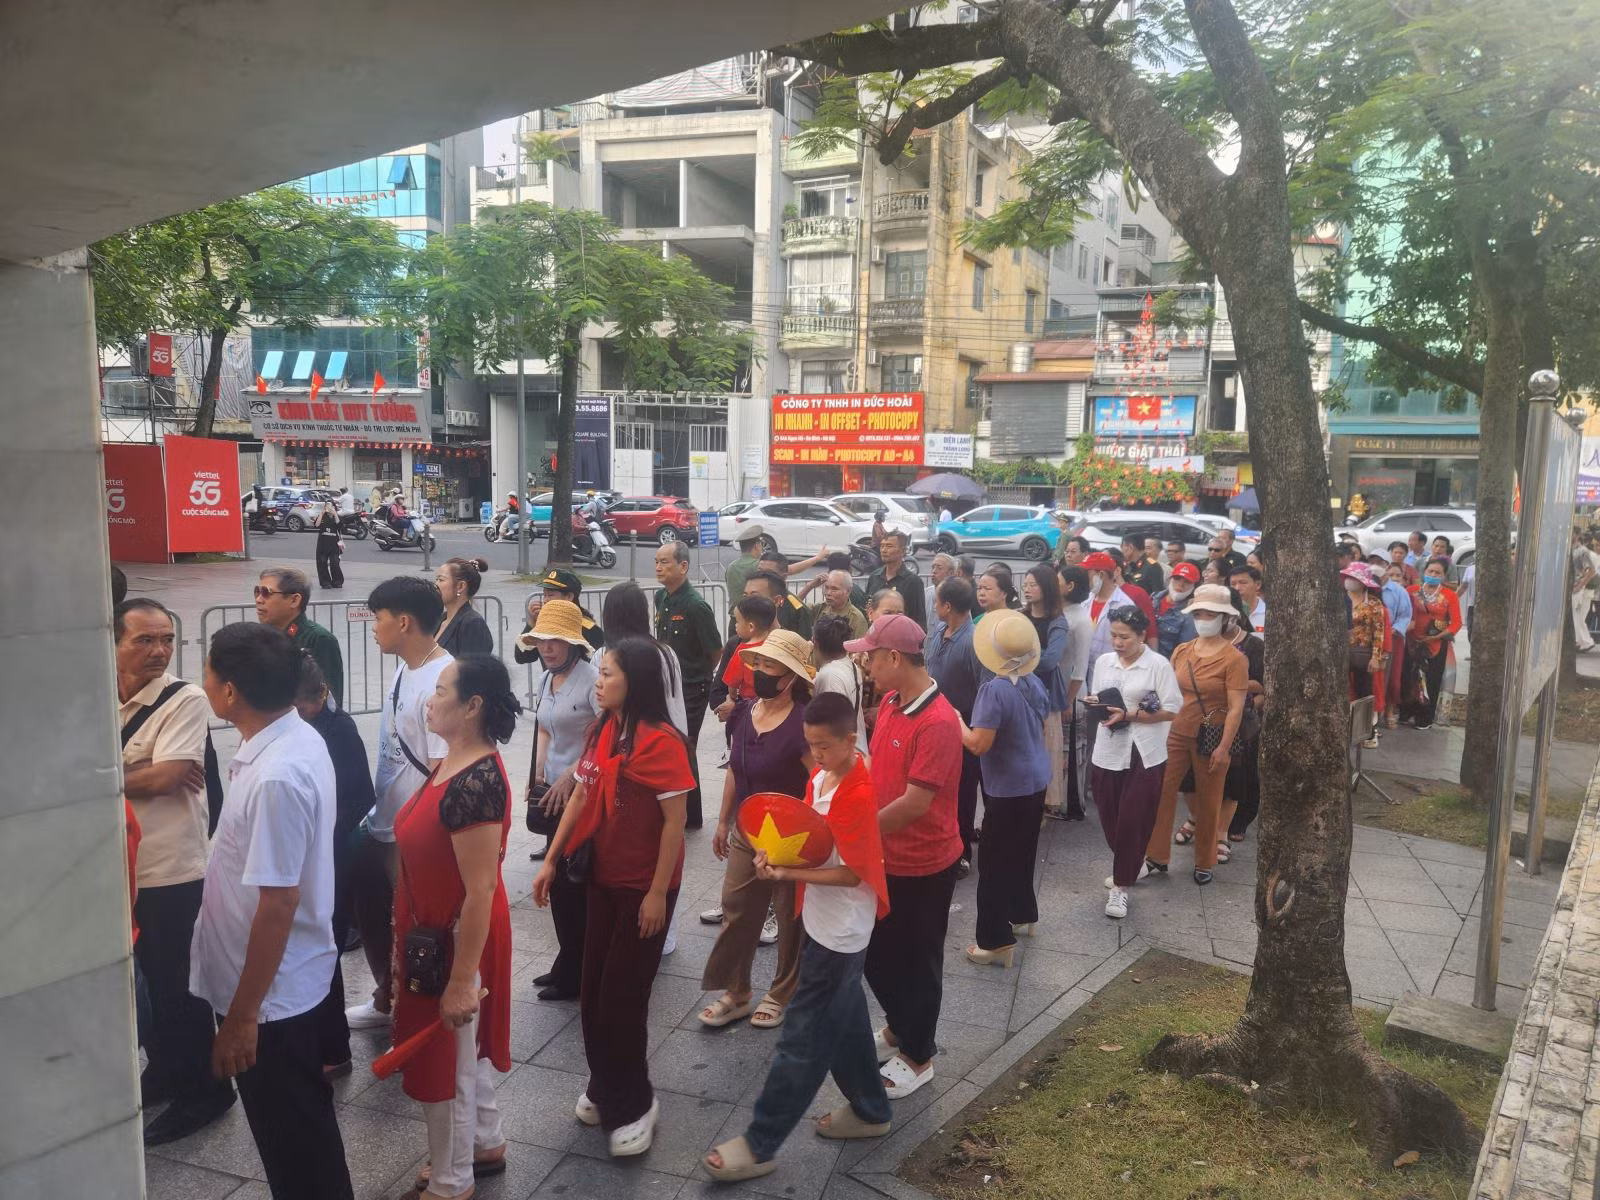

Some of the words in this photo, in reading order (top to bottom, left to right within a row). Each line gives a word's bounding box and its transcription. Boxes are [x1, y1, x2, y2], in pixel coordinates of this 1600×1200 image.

[152, 350, 168, 364] 5G
[782, 397, 809, 408] CÔNG
[812, 400, 821, 408] TY
[824, 399, 848, 408] TNHH
[851, 398, 860, 408] IN
[864, 395, 884, 408] ĐỨC
[775, 413, 784, 430] IN
[785, 413, 813, 430] NHANH
[820, 413, 830, 430] IN
[831, 412, 861, 430] OFFSET
[868, 411, 919, 430] PHOTOCOPY
[774, 448, 794, 461] SCAN
[834, 449, 882, 461] PHOTOCOPY
[1582, 448, 1600, 468] A
[194, 472, 220, 480] viettel
[189, 480, 221, 506] 5G
[106, 488, 126, 513] G
[106, 516, 122, 524] ỐNG
